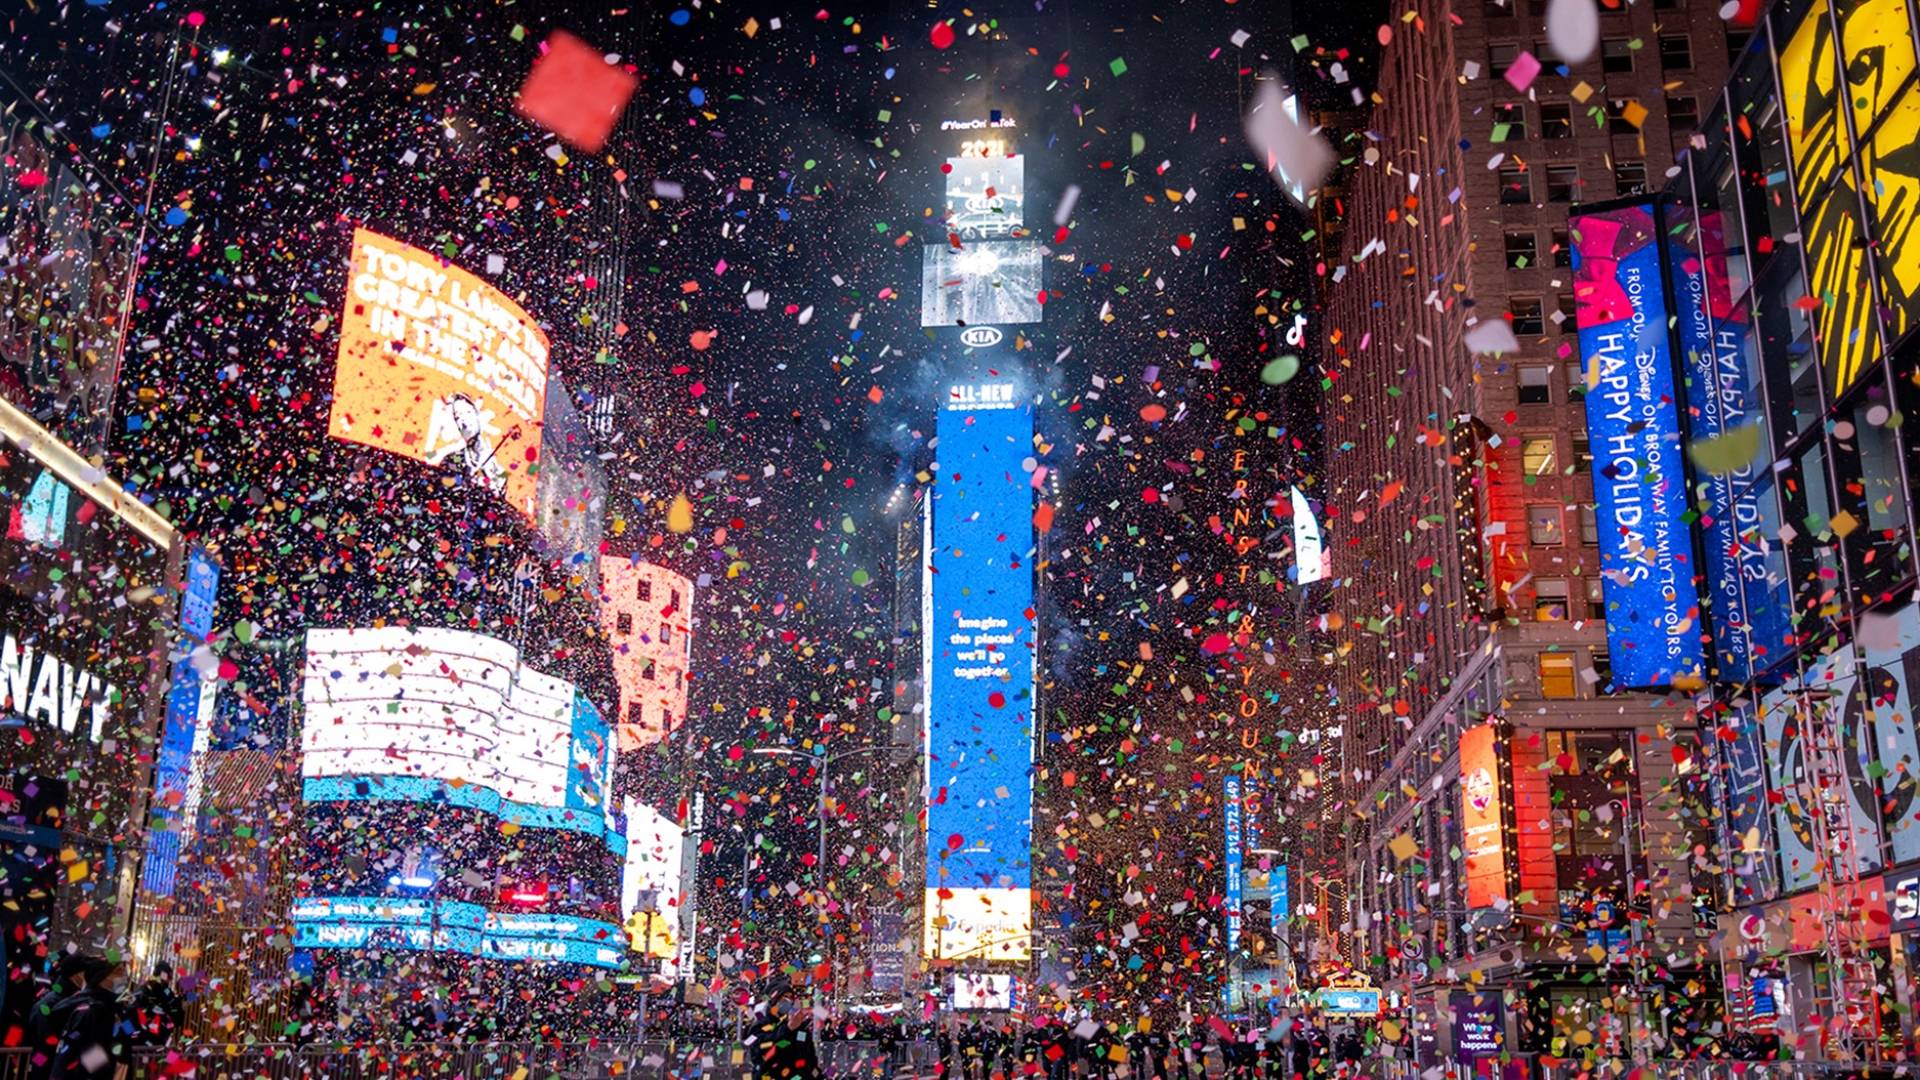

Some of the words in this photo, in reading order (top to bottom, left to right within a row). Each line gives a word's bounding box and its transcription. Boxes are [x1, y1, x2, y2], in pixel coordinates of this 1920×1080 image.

[961, 139, 1004, 158] 2021
[362, 244, 447, 296] TORY
[1627, 267, 1643, 307] FROM
[370, 305, 407, 341] IN
[412, 318, 467, 367] THE
[1629, 312, 1646, 341] OU
[949, 383, 1014, 402] ALL-NEW
[1597, 332, 1633, 424] HAPPY
[1642, 404, 1659, 429] ON
[1233, 451, 1250, 584] ERNST
[1607, 433, 1649, 583] HOLIDAYS
[1655, 520, 1673, 573] FAMILY
[1660, 577, 1677, 598] TO
[950, 633, 971, 644] the
[974, 633, 1015, 647] places
[1239, 614, 1255, 634] &
[957, 649, 986, 660] we'll
[989, 651, 1006, 664] go
[0, 634, 117, 744] NAVY
[1241, 666, 1262, 814] YOUNG
[692, 791, 704, 830] Locker
[1463, 1022, 1493, 1032] Whre
[1460, 1040, 1498, 1050] happens
